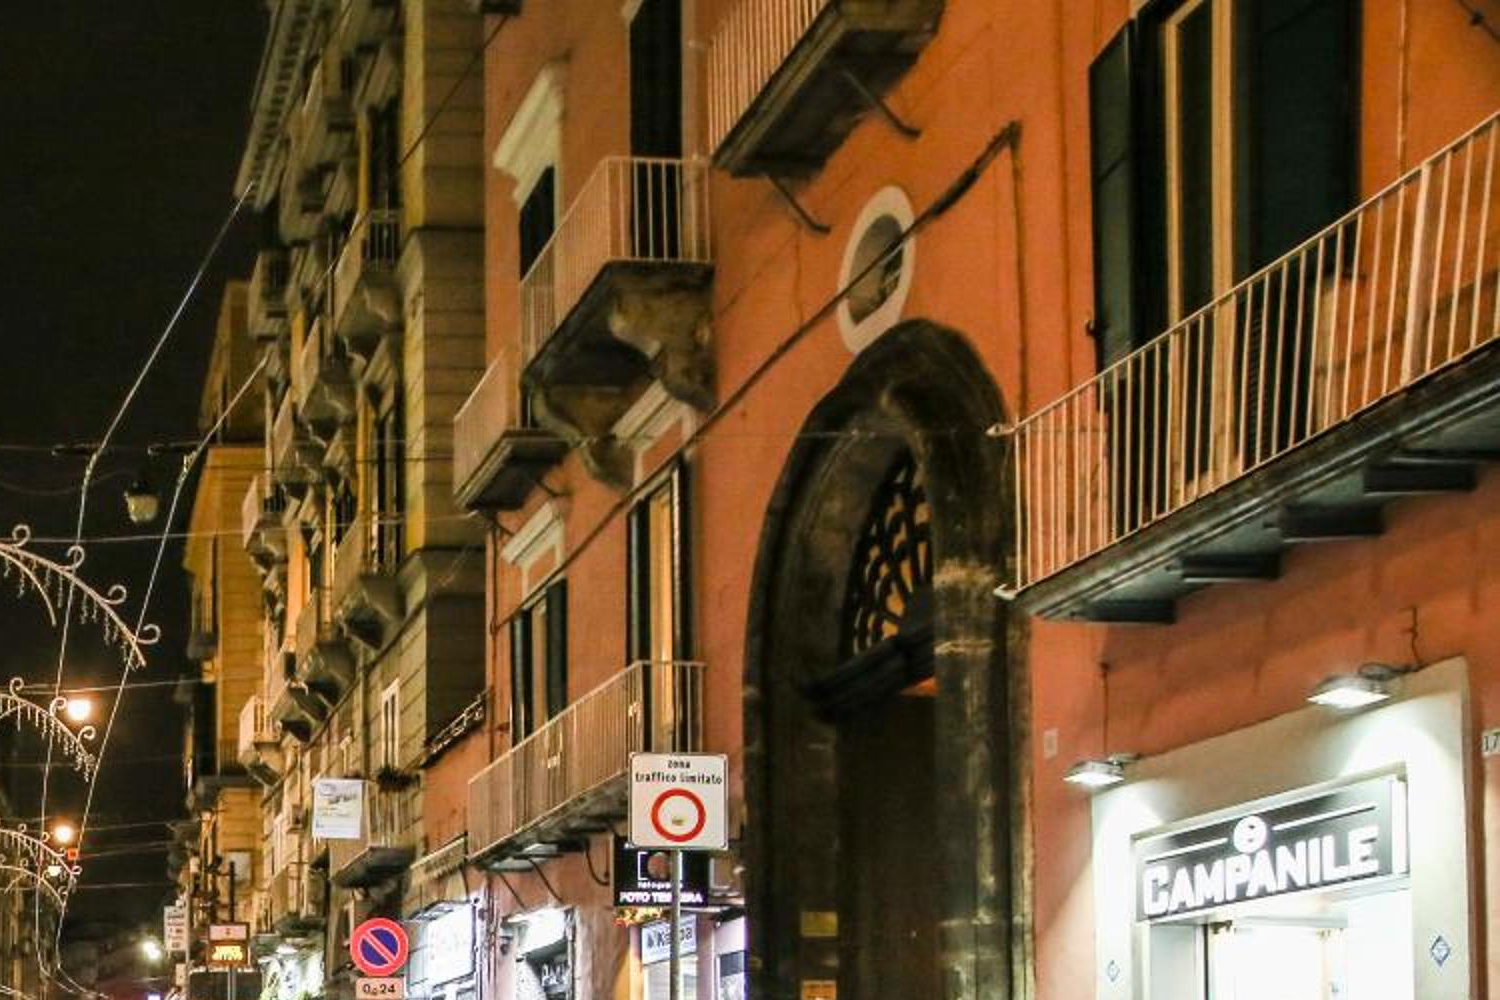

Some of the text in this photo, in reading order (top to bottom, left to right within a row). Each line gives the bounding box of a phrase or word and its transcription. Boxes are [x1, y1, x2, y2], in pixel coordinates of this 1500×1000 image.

[668, 760, 691, 769] zona
[635, 771, 723, 785] traffico limitato
[1143, 826, 1379, 915] CAMPANILE
